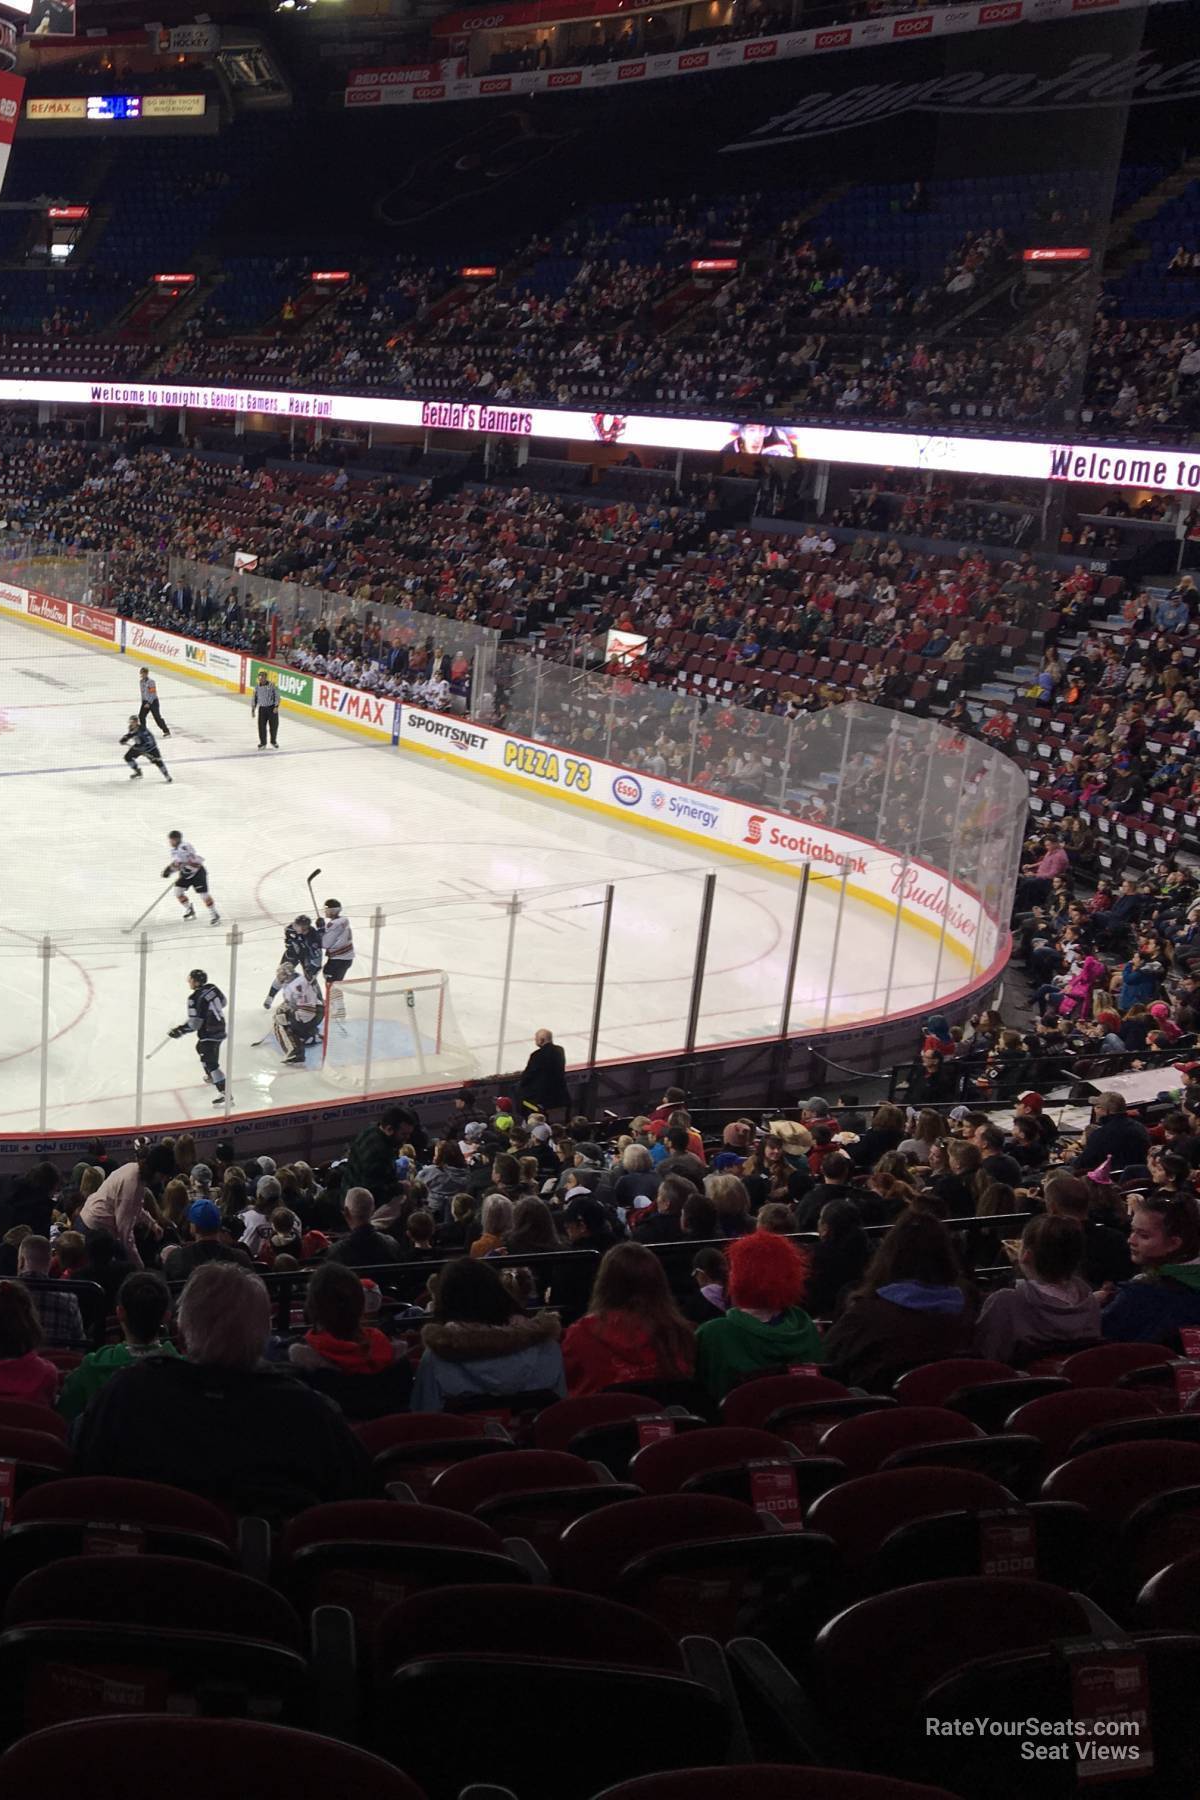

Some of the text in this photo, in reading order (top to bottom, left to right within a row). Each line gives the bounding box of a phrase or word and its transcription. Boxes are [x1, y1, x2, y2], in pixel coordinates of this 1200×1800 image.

[463, 15, 504, 30] CO-OP
[983, 6, 1018, 20] CO-OP
[898, 20, 929, 33] CO-OP
[173, 37, 209, 48] HOCKEY
[818, 33, 848, 45] CO-OP
[747, 44, 774, 56] CO-OP
[681, 56, 706, 67] CO-OP
[354, 69, 431, 85] RED CORNER
[551, 74, 579, 85] CO-OP
[0, 97, 18, 117] RED
[31, 103, 71, 113] RE/MAX
[91, 386, 145, 402] Welcome
[148, 390, 158, 403] to
[247, 394, 278, 411] Gamers
[289, 396, 310, 413] Have
[314, 398, 333, 416] Fun!
[421, 401, 533, 433] Getzlaf's Gamers
[1051, 449, 1200, 487] Welcome to
[29, 594, 41, 614] Tim
[41, 599, 67, 624] Hortons
[131, 622, 180, 658] Budweiser
[319, 685, 385, 726] RE/MAX
[408, 714, 489, 750] SPORTSNET
[505, 740, 592, 792] PIZZA 73
[616, 781, 638, 799] Esso
[669, 797, 719, 829] Synergy
[769, 827, 867, 876] Scotiabank
[890, 862, 978, 936] Budweiser
